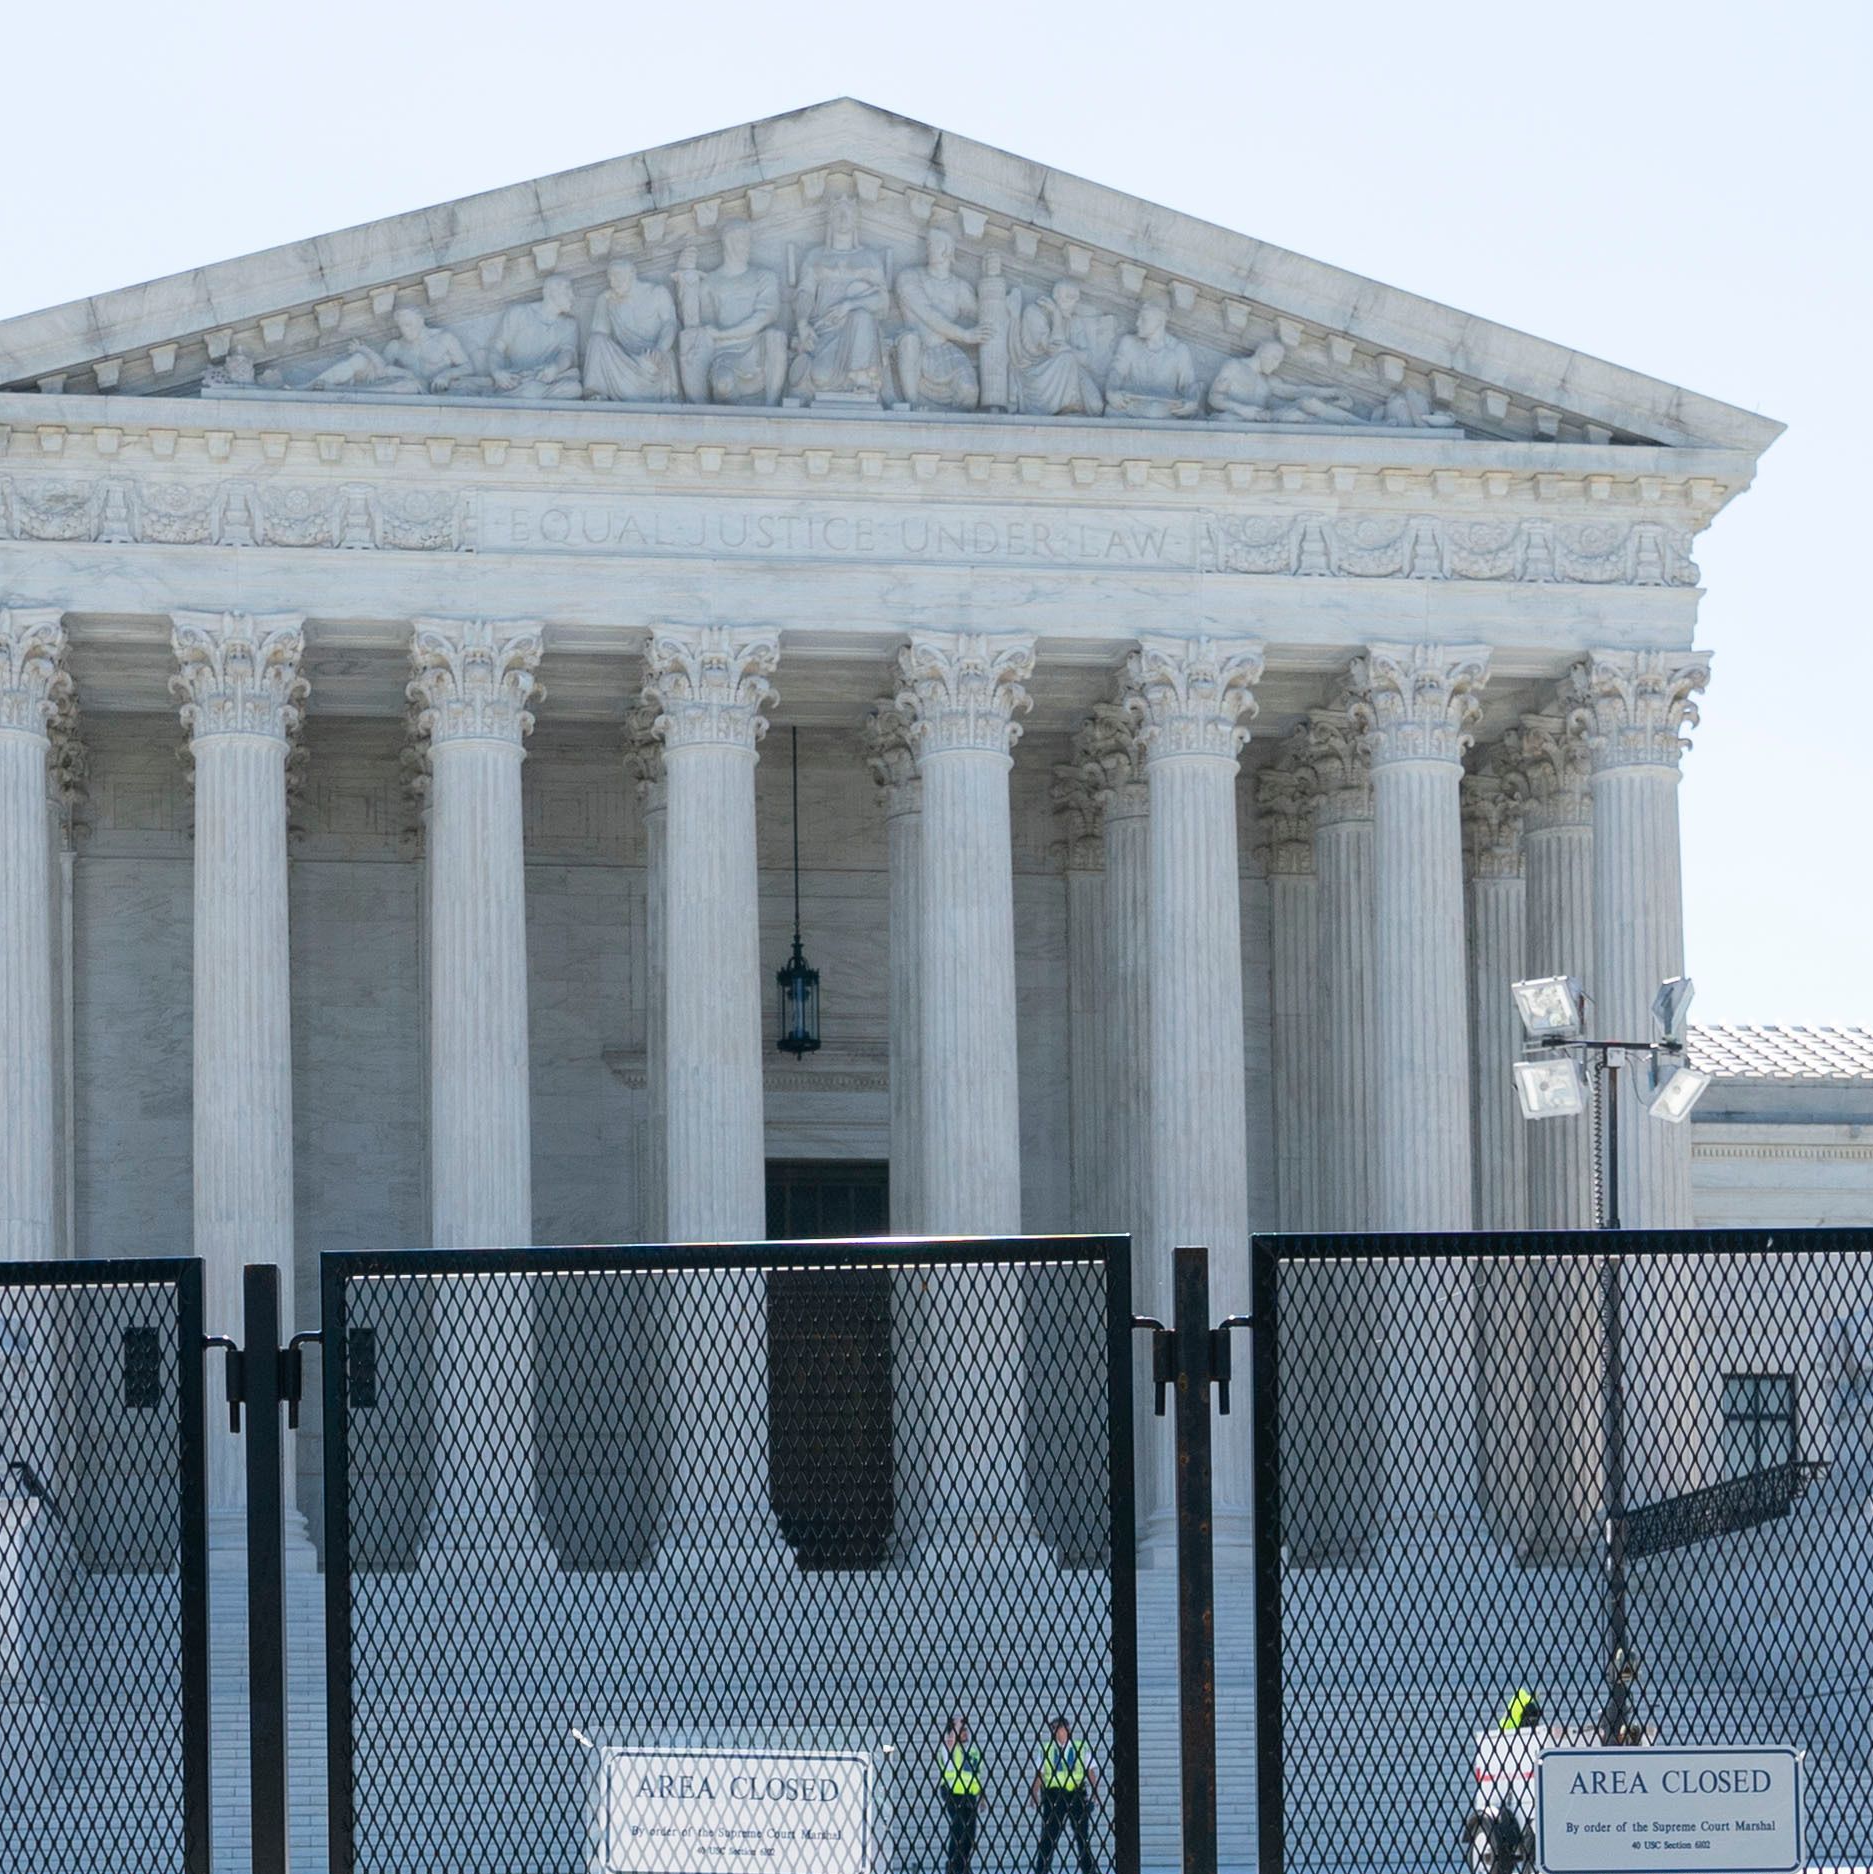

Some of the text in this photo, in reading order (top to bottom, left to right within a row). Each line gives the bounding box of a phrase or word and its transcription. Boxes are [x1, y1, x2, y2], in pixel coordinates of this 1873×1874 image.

[510, 508, 1168, 559] EQUAL JUSTICE UNDER LAW
[635, 1775, 839, 1801] AREA CLOSED
[1569, 1769, 1771, 1795] AREA CLOSED
[650, 1826, 677, 1837] order
[698, 1827, 715, 1837] the
[718, 1827, 762, 1840] Supreme
[767, 1829, 795, 1839] Court
[801, 1829, 842, 1841] Marshal
[1584, 1822, 1611, 1833] order
[1633, 1822, 1649, 1832] the
[1652, 1821, 1696, 1834] Supreme
[1701, 1821, 1730, 1832] Court
[1735, 1820, 1776, 1831] Marshal
[1644, 1841, 1661, 1850] USC
[1663, 1840, 1691, 1849] Section
